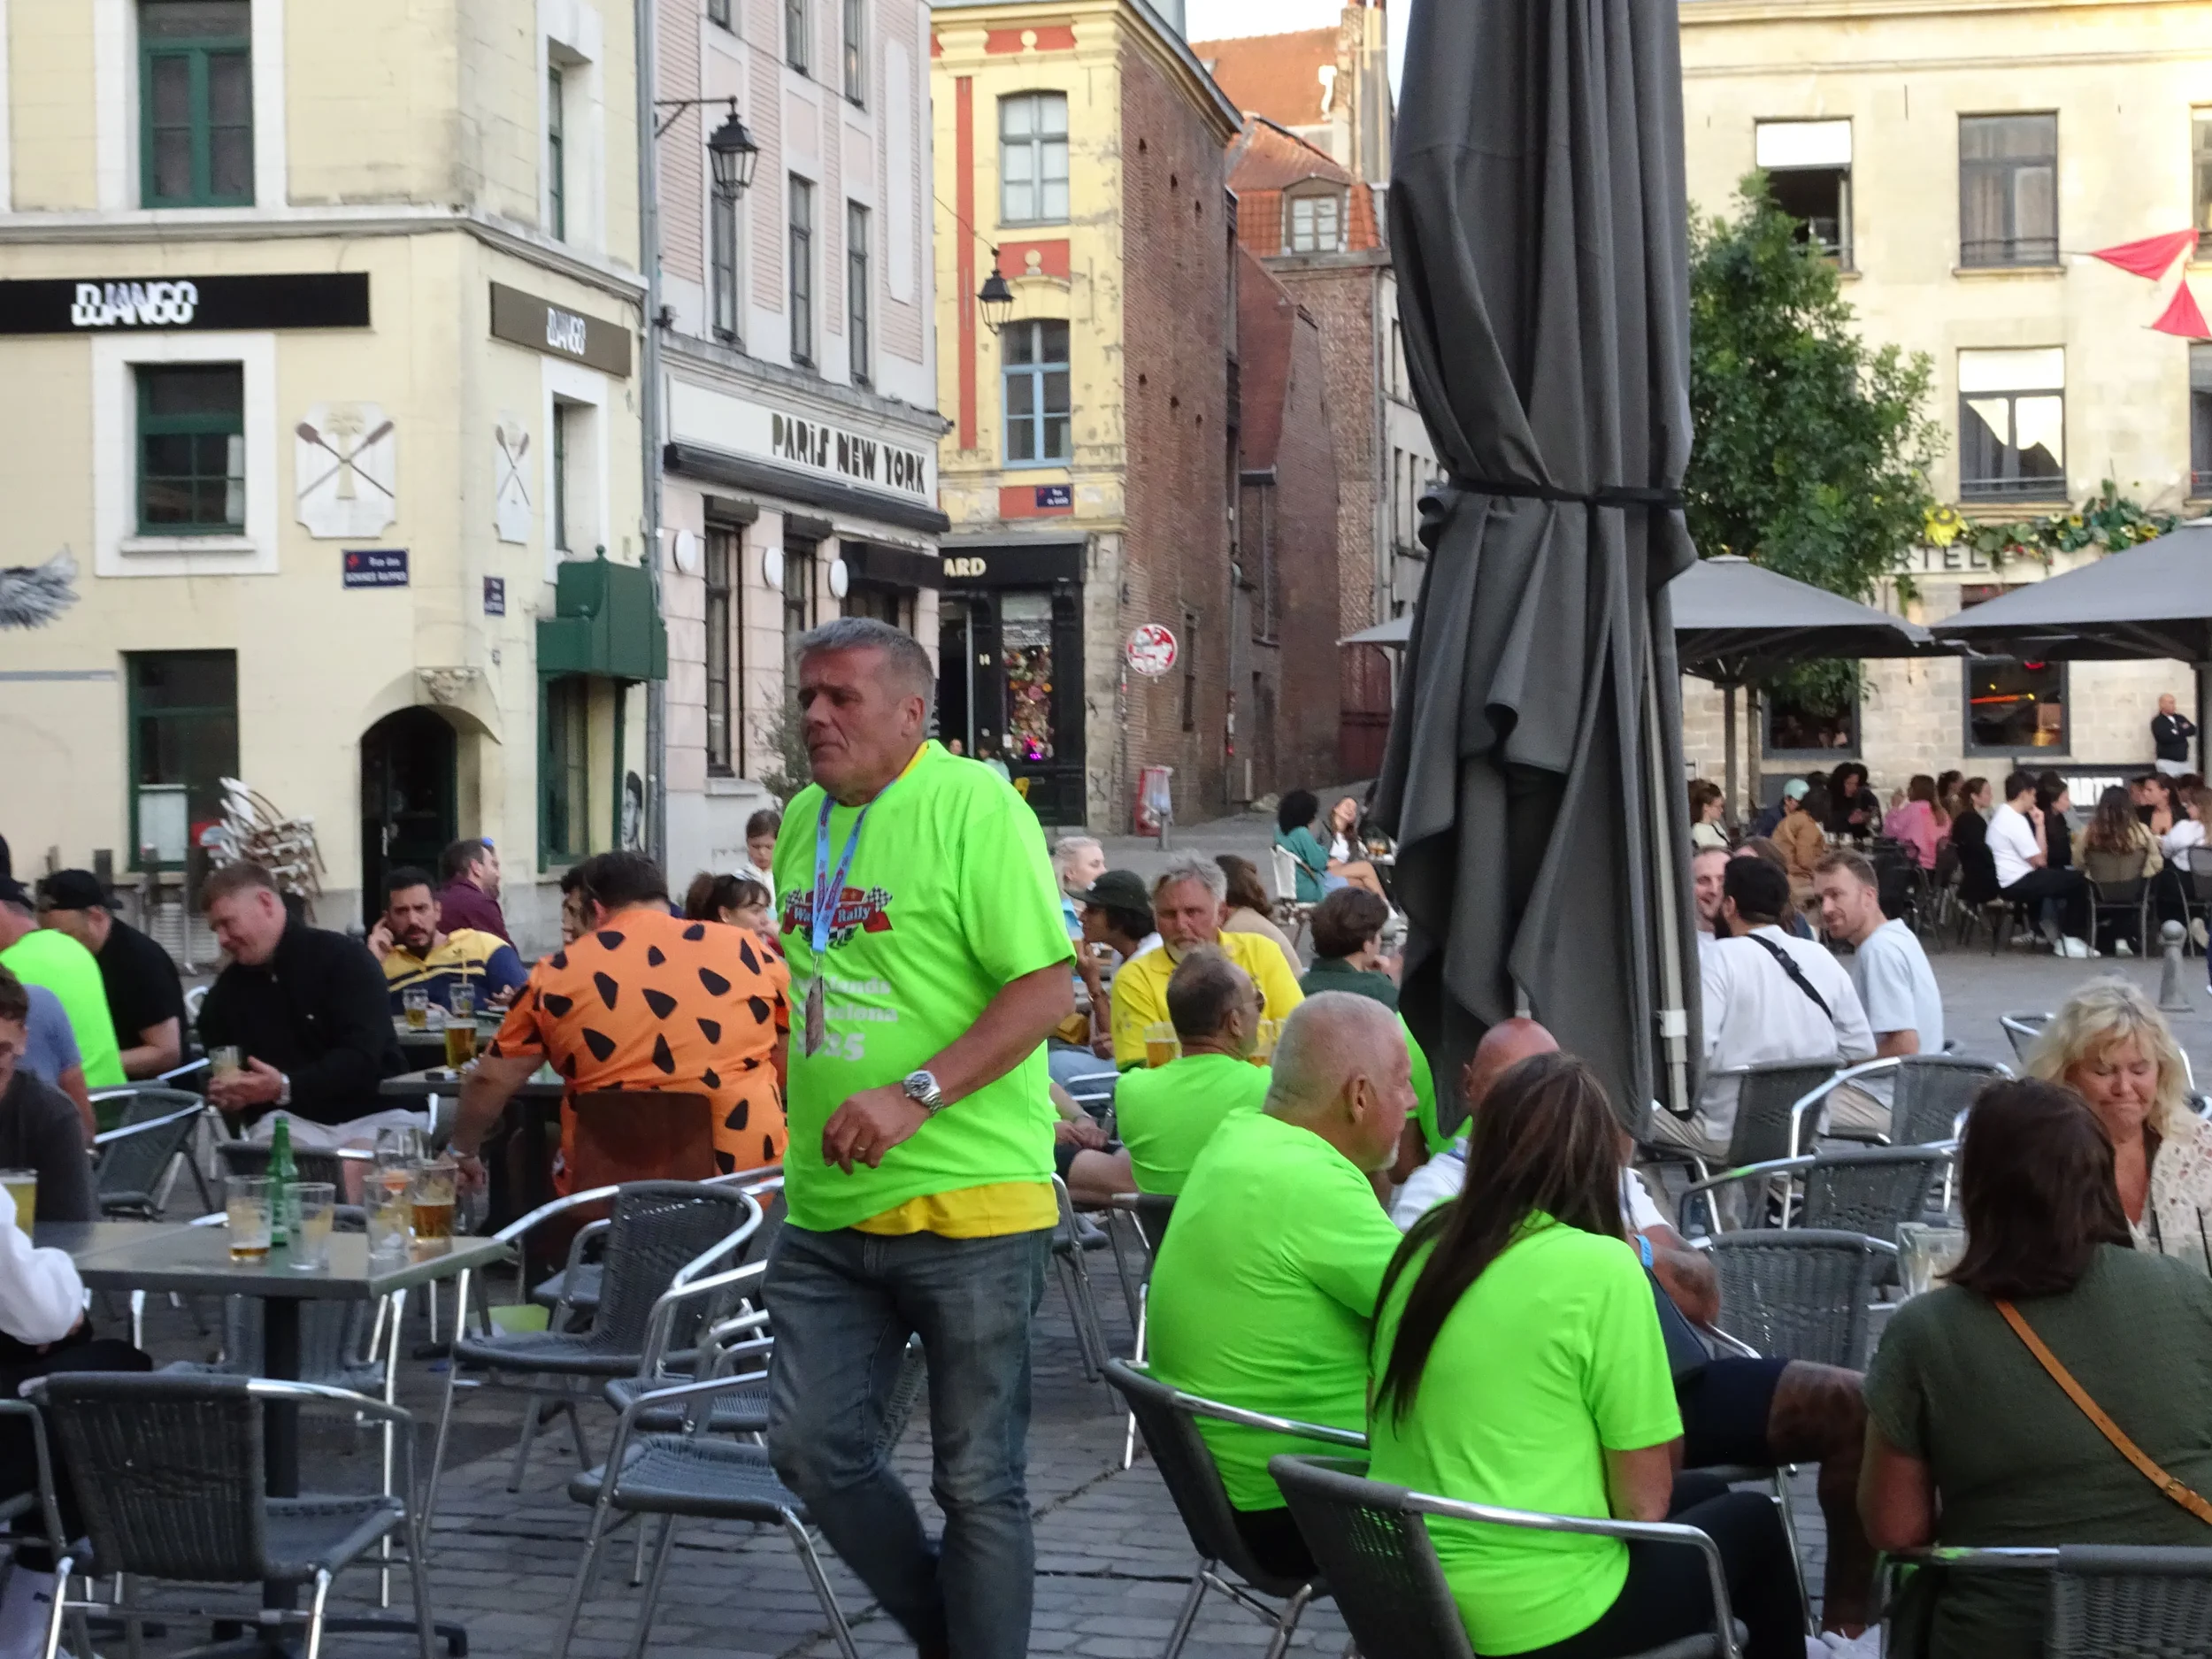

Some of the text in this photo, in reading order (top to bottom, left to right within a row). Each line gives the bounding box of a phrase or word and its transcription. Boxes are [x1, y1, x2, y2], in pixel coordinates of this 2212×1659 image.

[836, 432, 877, 481] NEW
[883, 445, 926, 495] YORK
[943, 557, 987, 578] ARD
[838, 906, 871, 923] Rally
